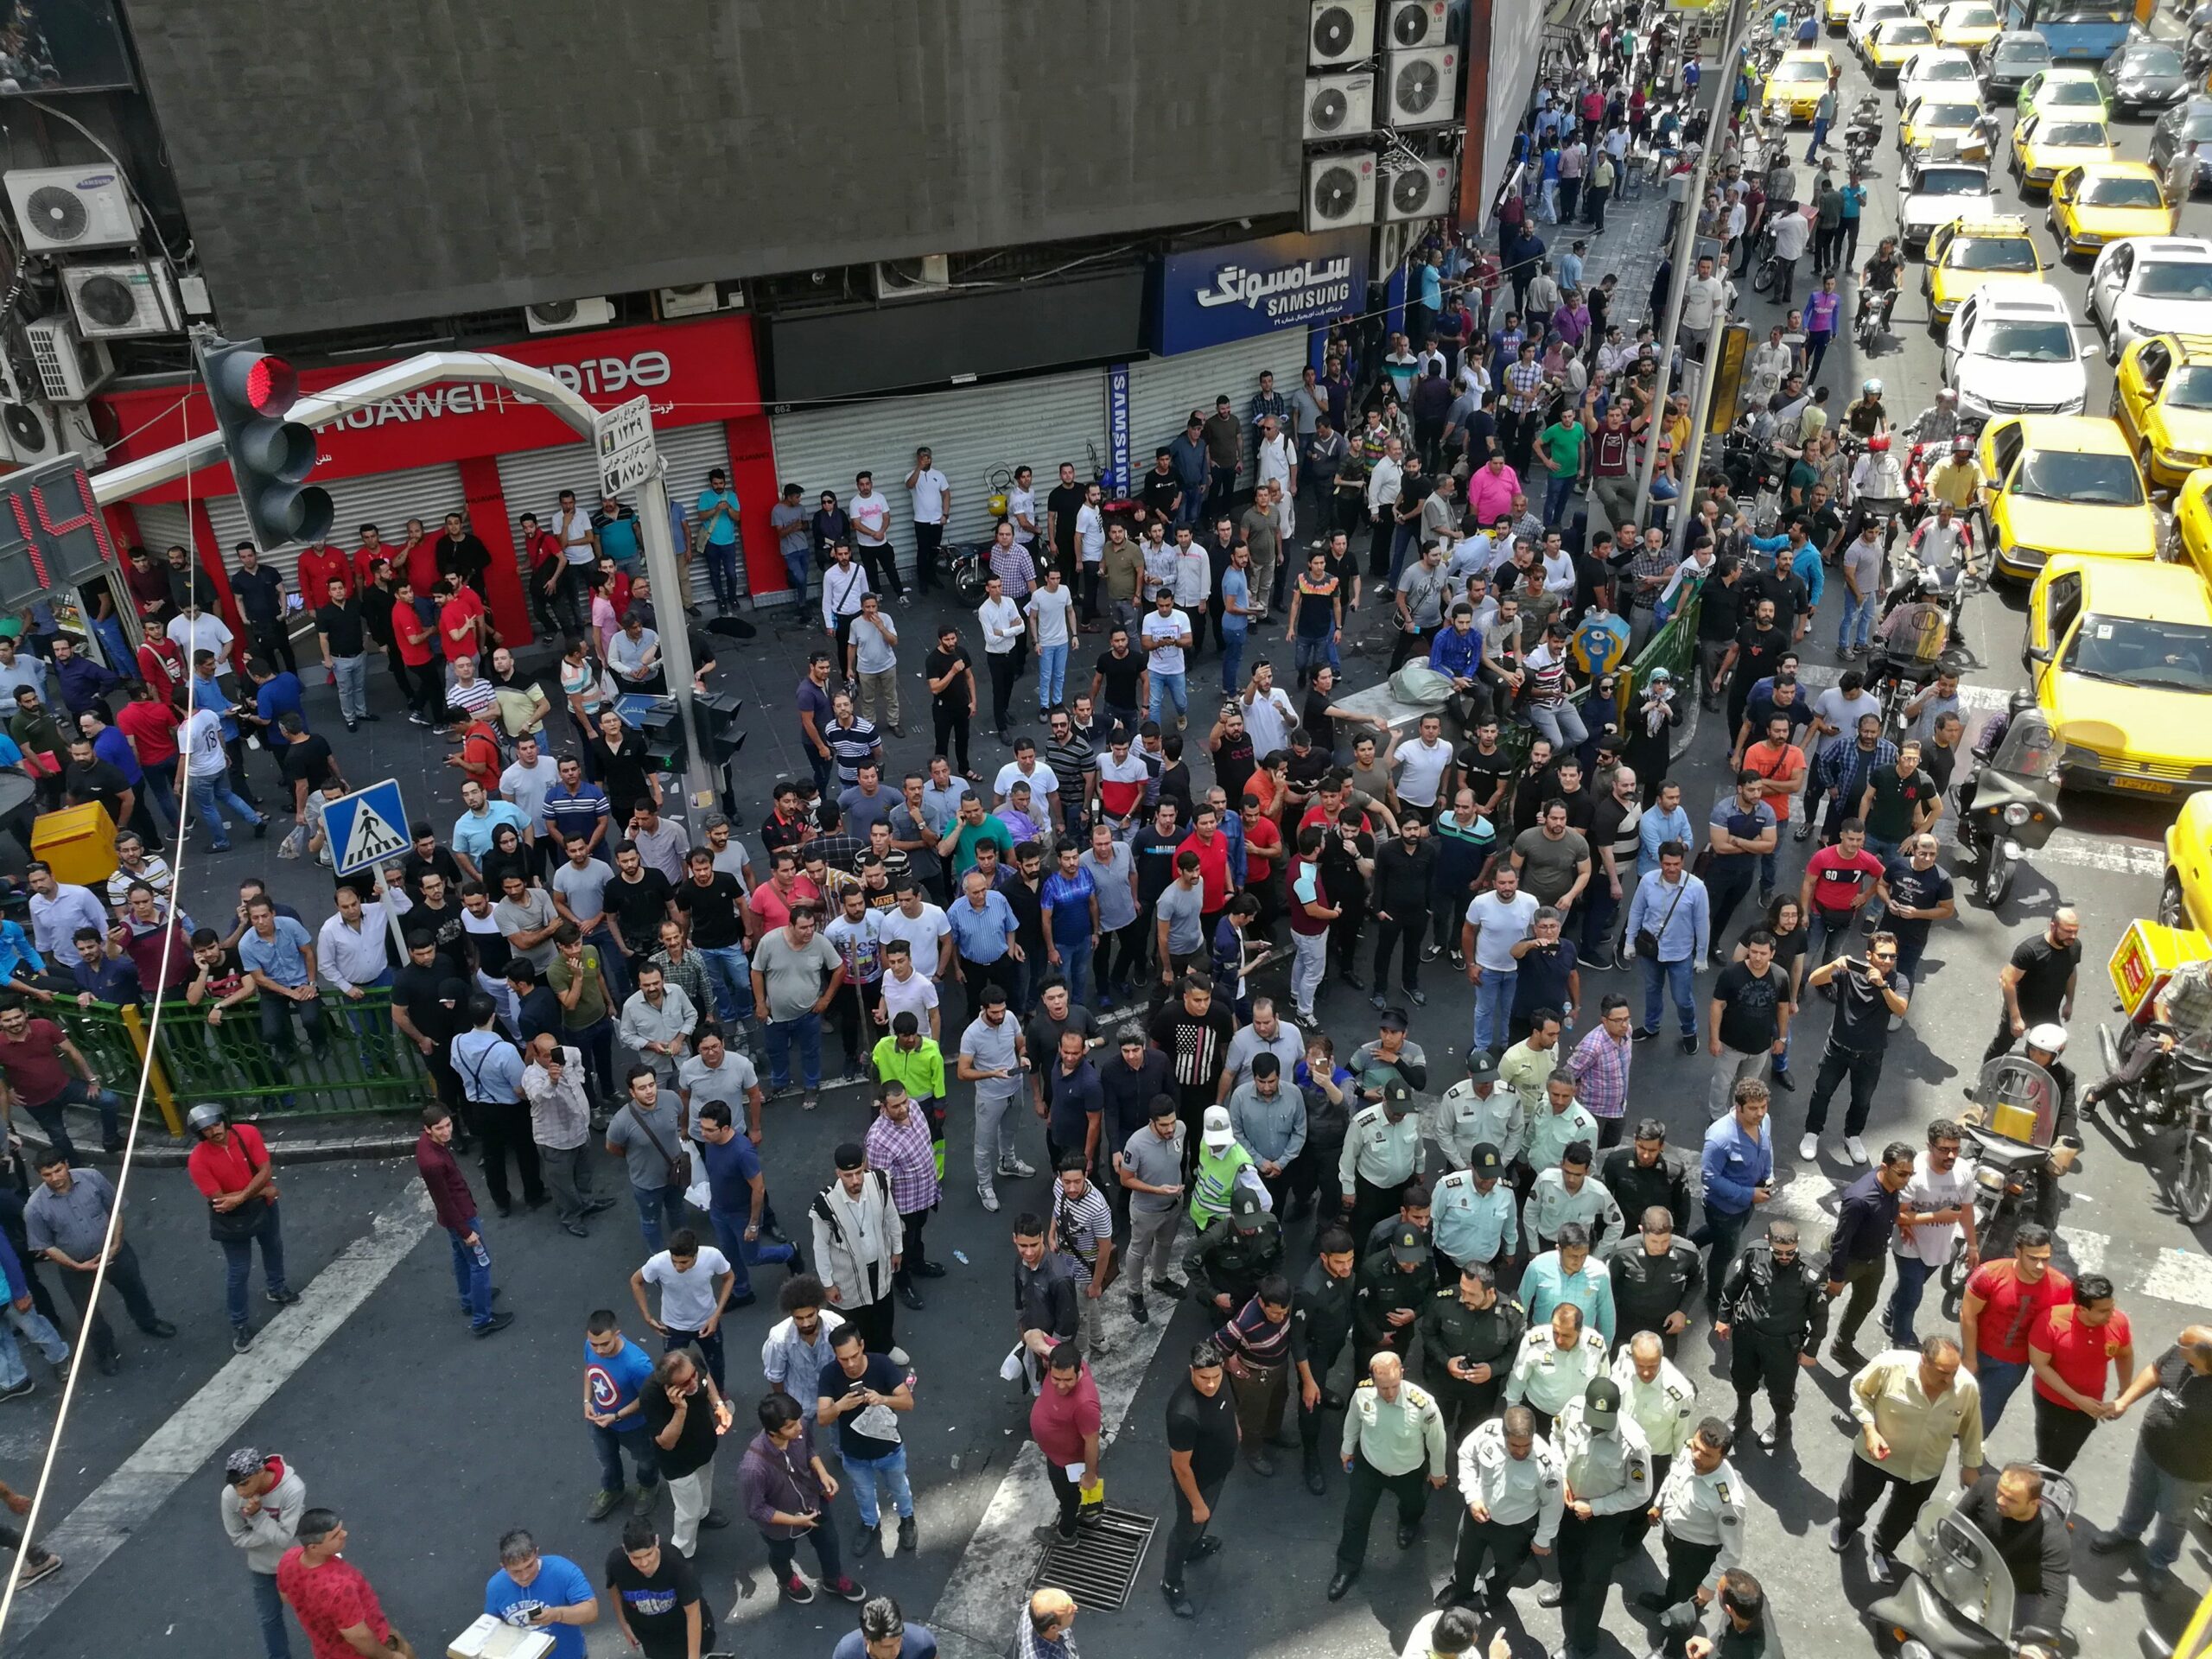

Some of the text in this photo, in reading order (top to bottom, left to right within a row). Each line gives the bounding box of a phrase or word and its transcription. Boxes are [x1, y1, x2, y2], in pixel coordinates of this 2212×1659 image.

[1197, 257, 1351, 309] سامسونگ
[1268, 283, 1350, 316] SAMSUNG
[774, 404, 791, 414] 662
[619, 416, 643, 442] ۱۲۳۹
[1114, 375, 1128, 499] SAMSUNG
[603, 458, 620, 473] خرابی
[622, 445, 639, 463] گزارش
[622, 461, 648, 484] ۸۷۵۰
[10, 468, 111, 589] 14
[206, 730, 217, 753] 18
[1825, 869, 1861, 884] SD 7
[870, 893, 895, 907] VANS
[501, 1602, 518, 1618] LAS
